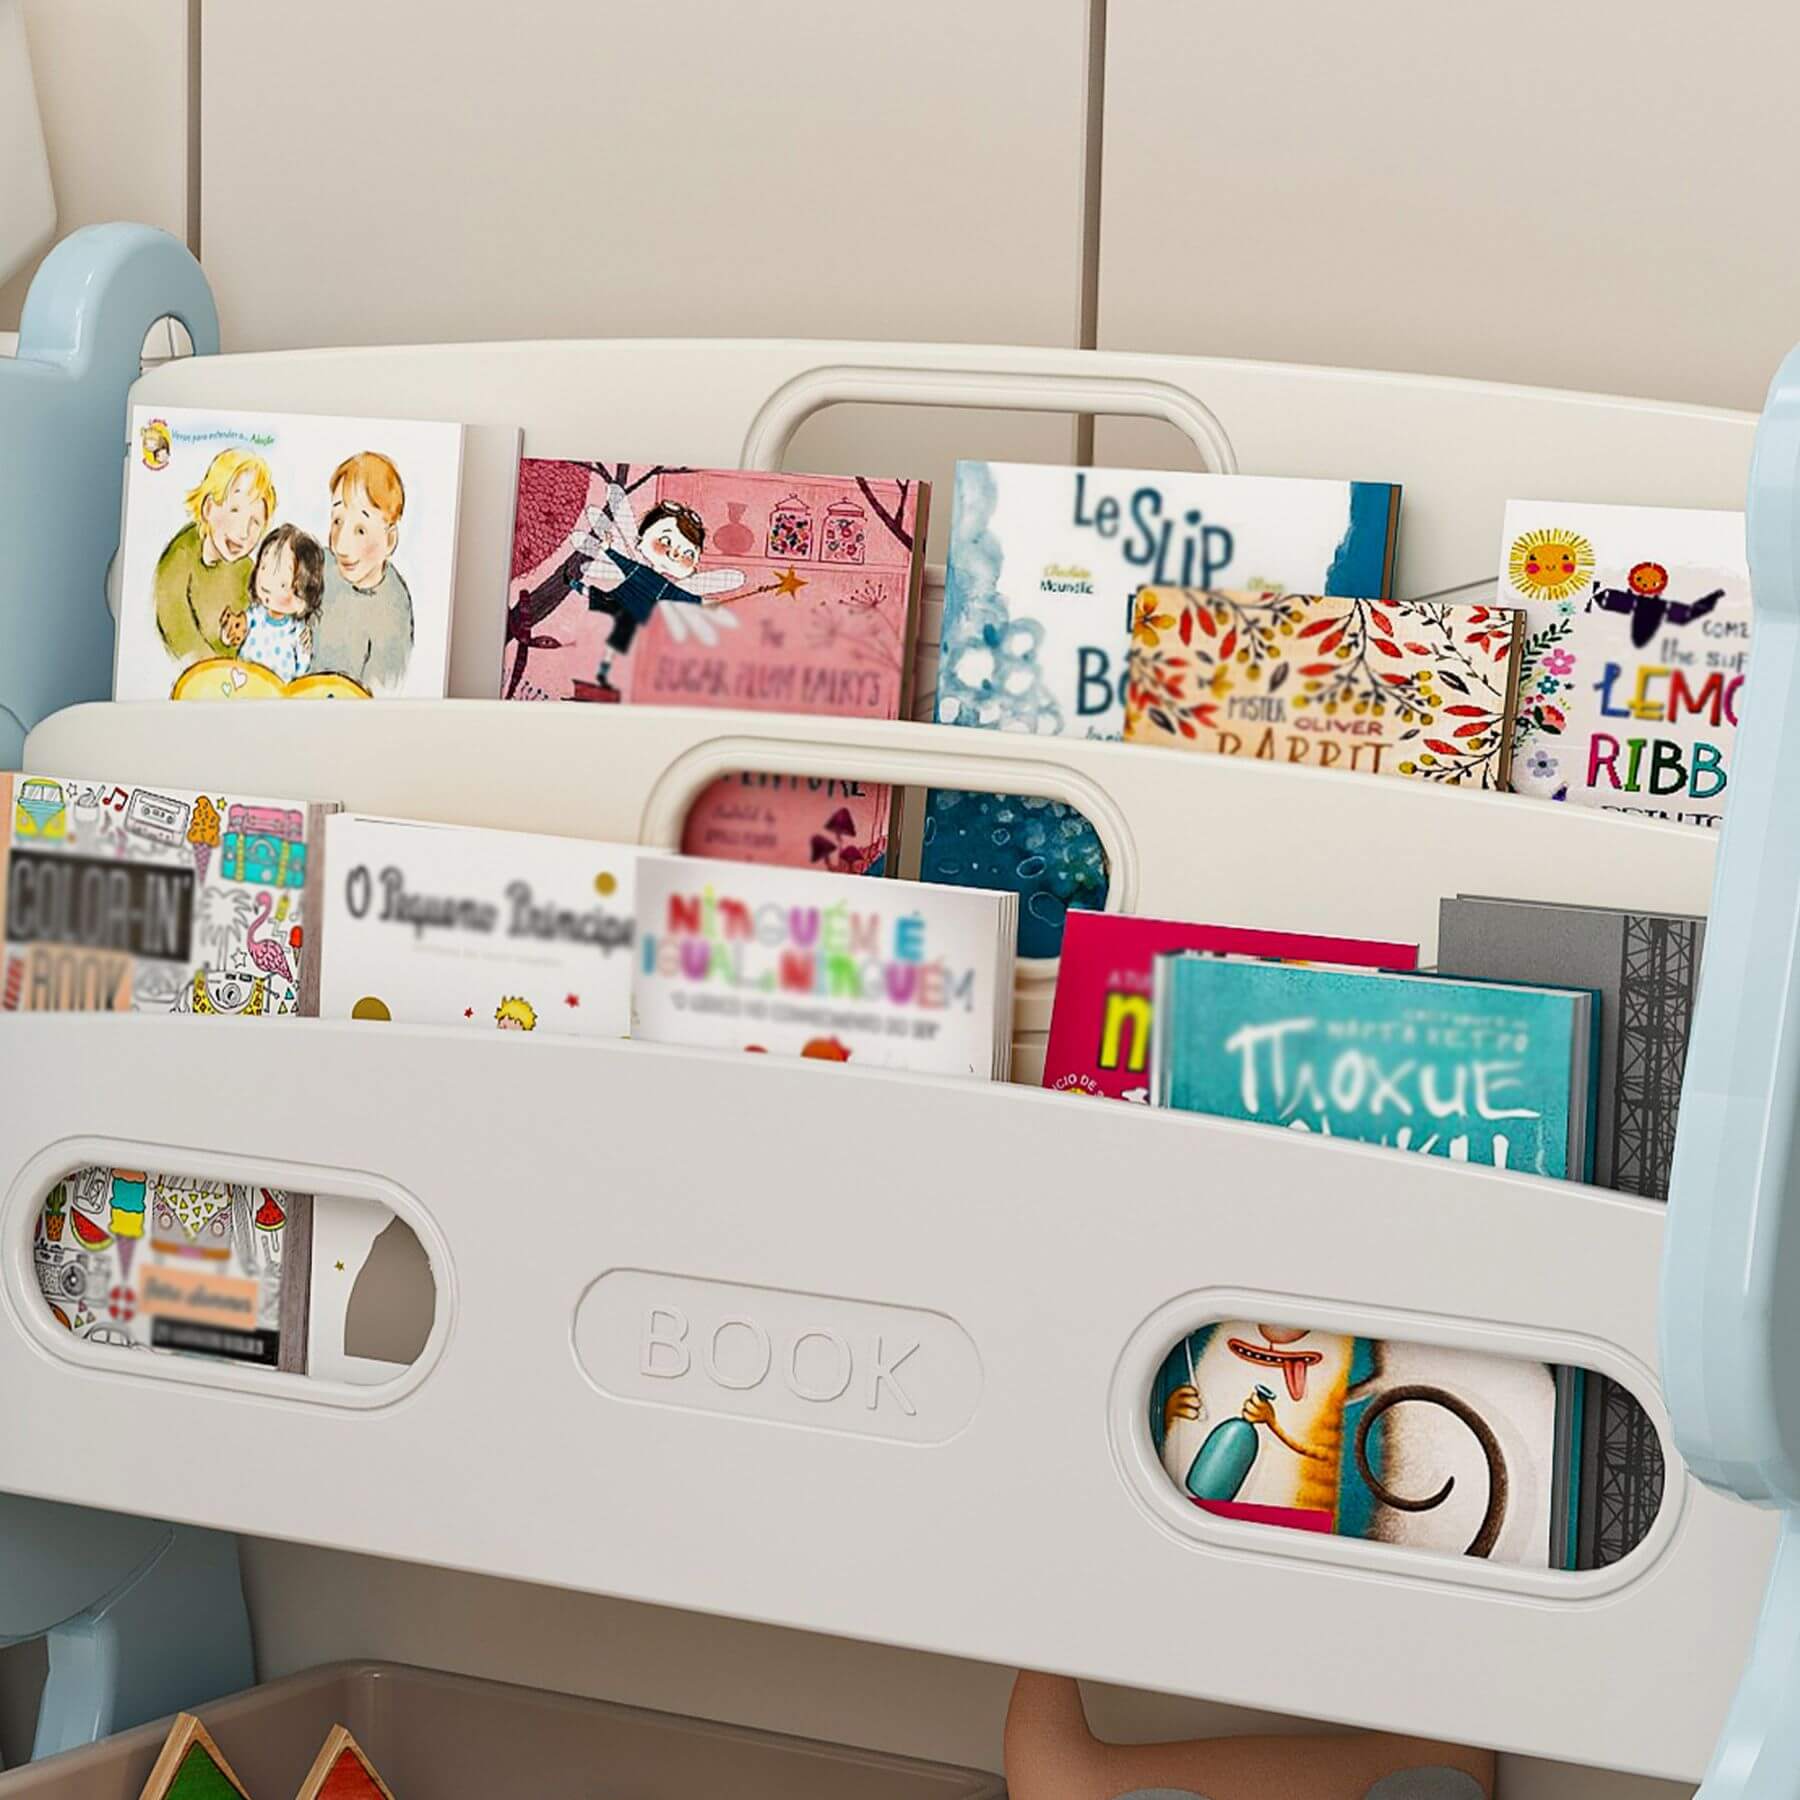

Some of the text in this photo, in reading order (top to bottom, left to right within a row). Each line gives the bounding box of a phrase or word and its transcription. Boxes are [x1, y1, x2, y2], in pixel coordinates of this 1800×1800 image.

[1074, 473, 1120, 539] Le
[1228, 696, 1287, 723] MISTER
[1295, 716, 1384, 736] OLIVER
[1586, 733, 1728, 799] RIBB
[346, 865, 371, 919] O
[638, 1306, 921, 1416] BOOK
